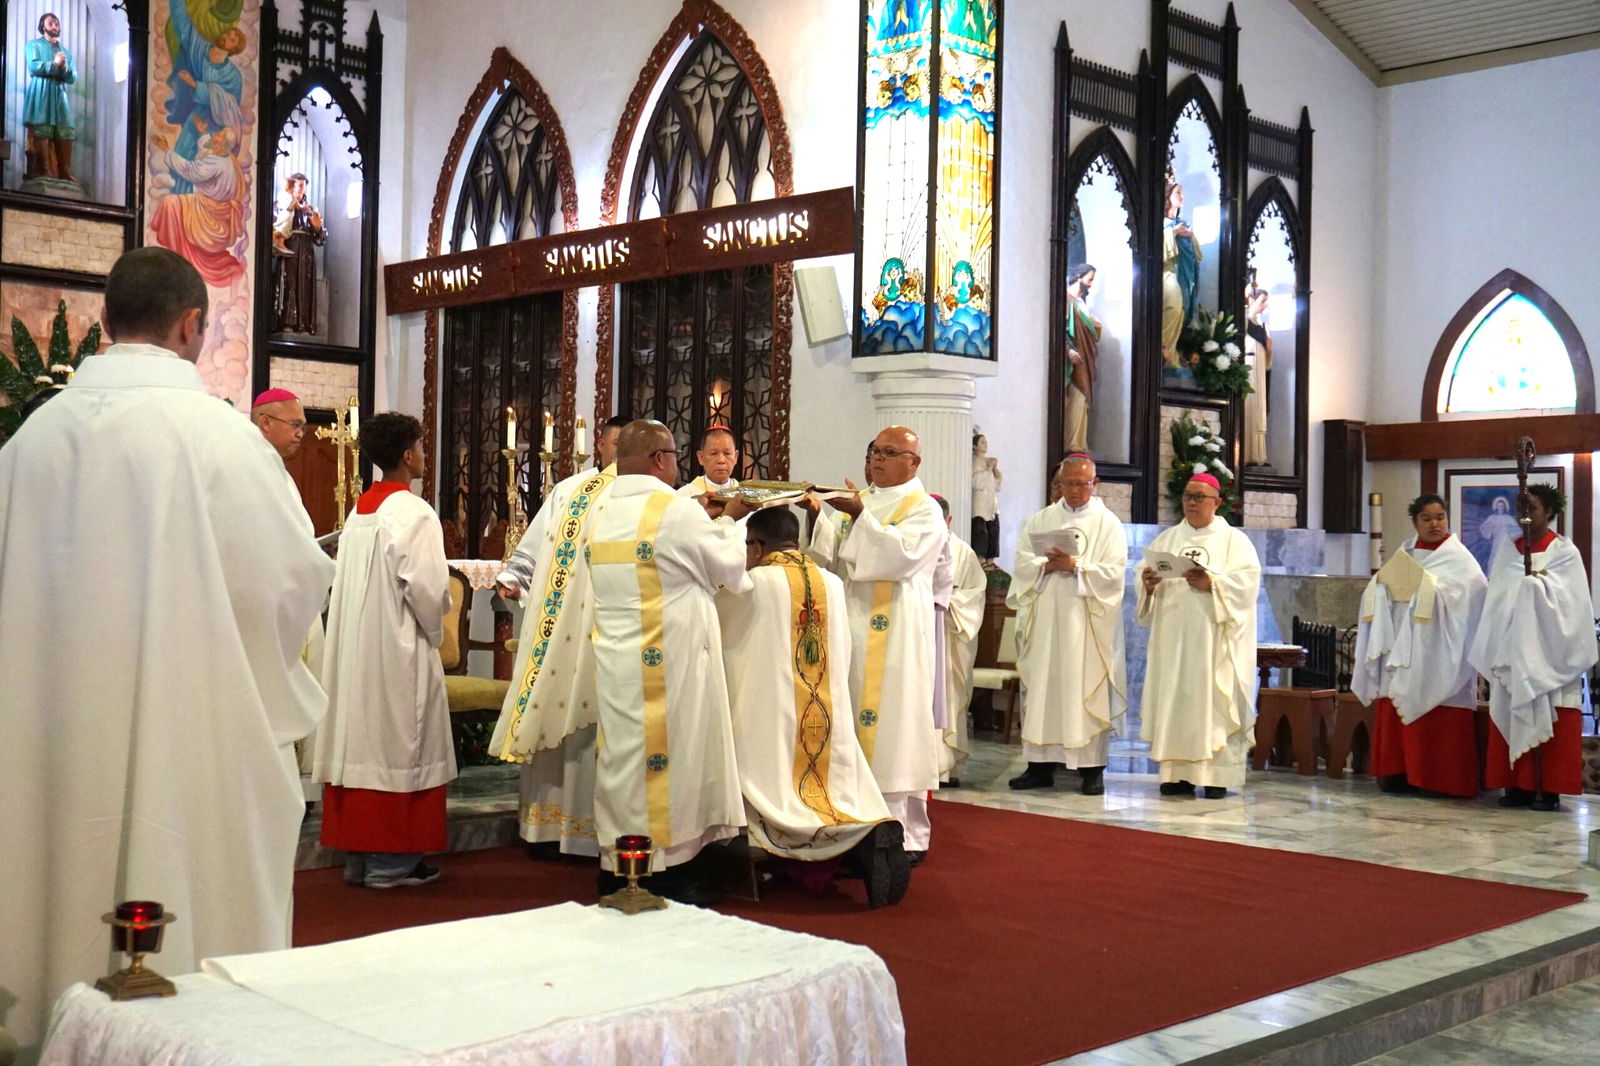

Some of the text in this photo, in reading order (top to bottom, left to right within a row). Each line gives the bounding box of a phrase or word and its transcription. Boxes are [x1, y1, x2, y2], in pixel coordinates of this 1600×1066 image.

[411, 209, 810, 296] SANCTUS SANCTUS SANCTUS
